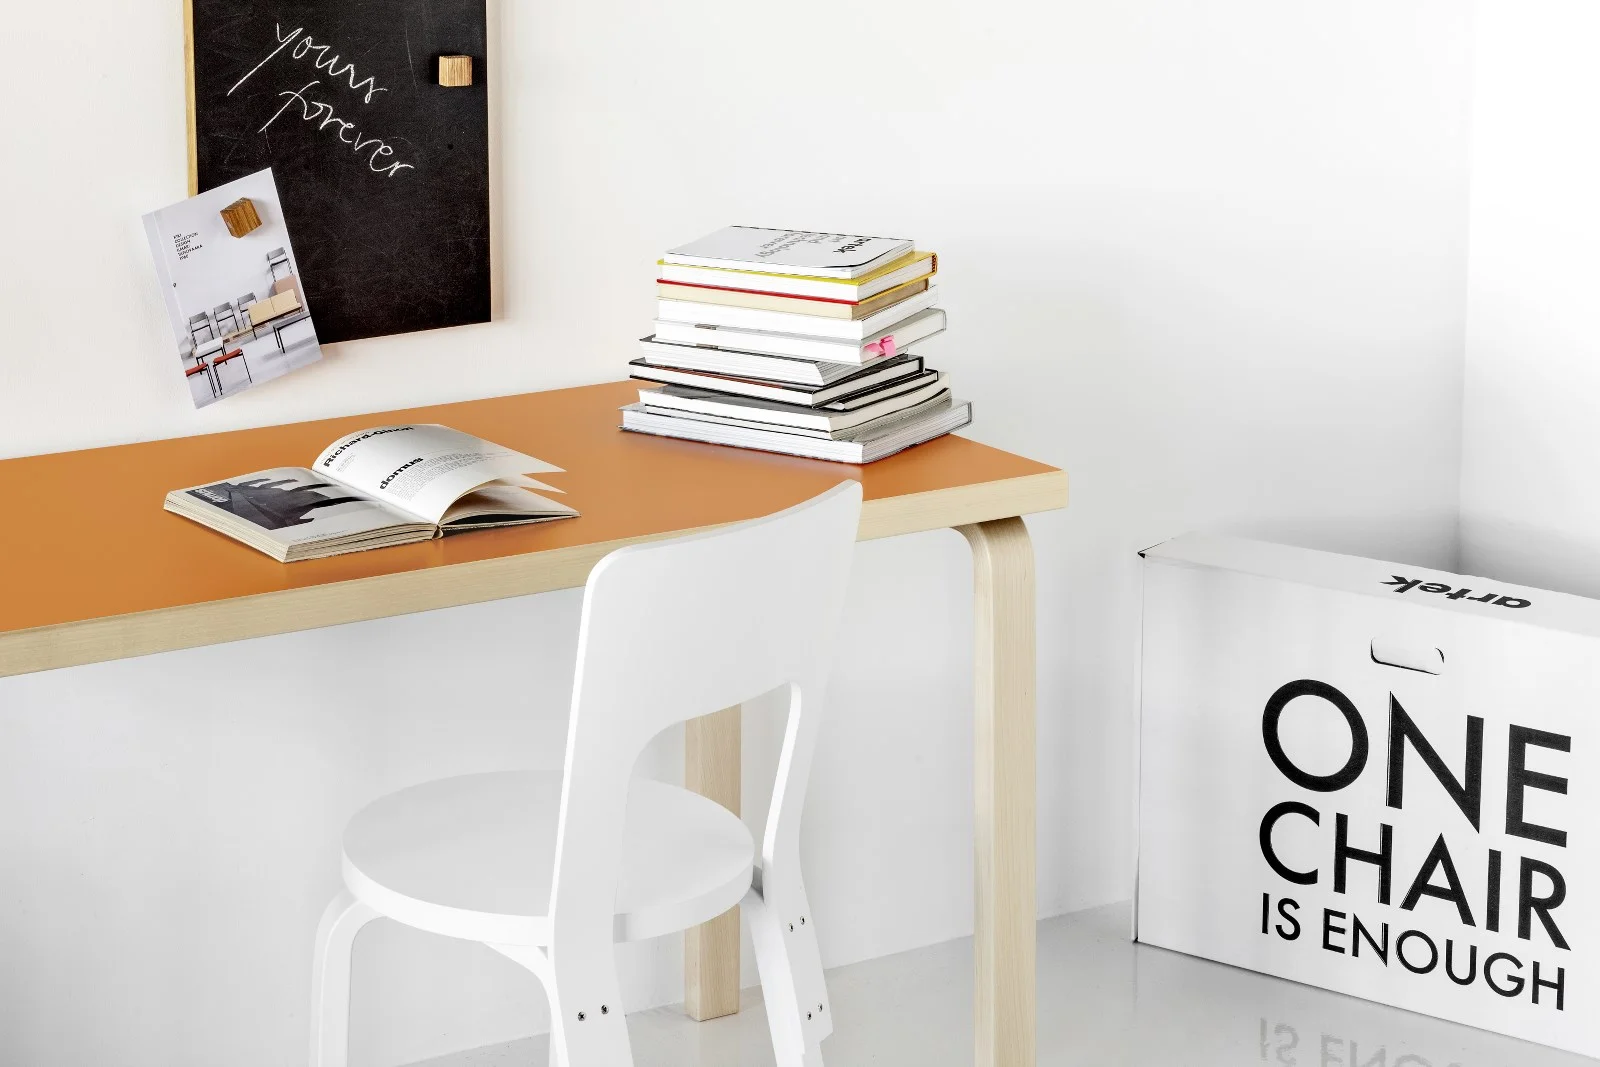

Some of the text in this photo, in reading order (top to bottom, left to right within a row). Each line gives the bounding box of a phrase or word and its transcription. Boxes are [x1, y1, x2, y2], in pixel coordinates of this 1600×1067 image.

[227, 22, 388, 103] yours
[257, 80, 415, 178] forever
[833, 238, 872, 254] artek
[379, 456, 424, 490] domus
[1379, 574, 1532, 609] artek
[1262, 679, 1571, 848] ONE
[1259, 801, 1571, 951] CHAIR
[1261, 892, 1565, 1011] IS ENOUGH
